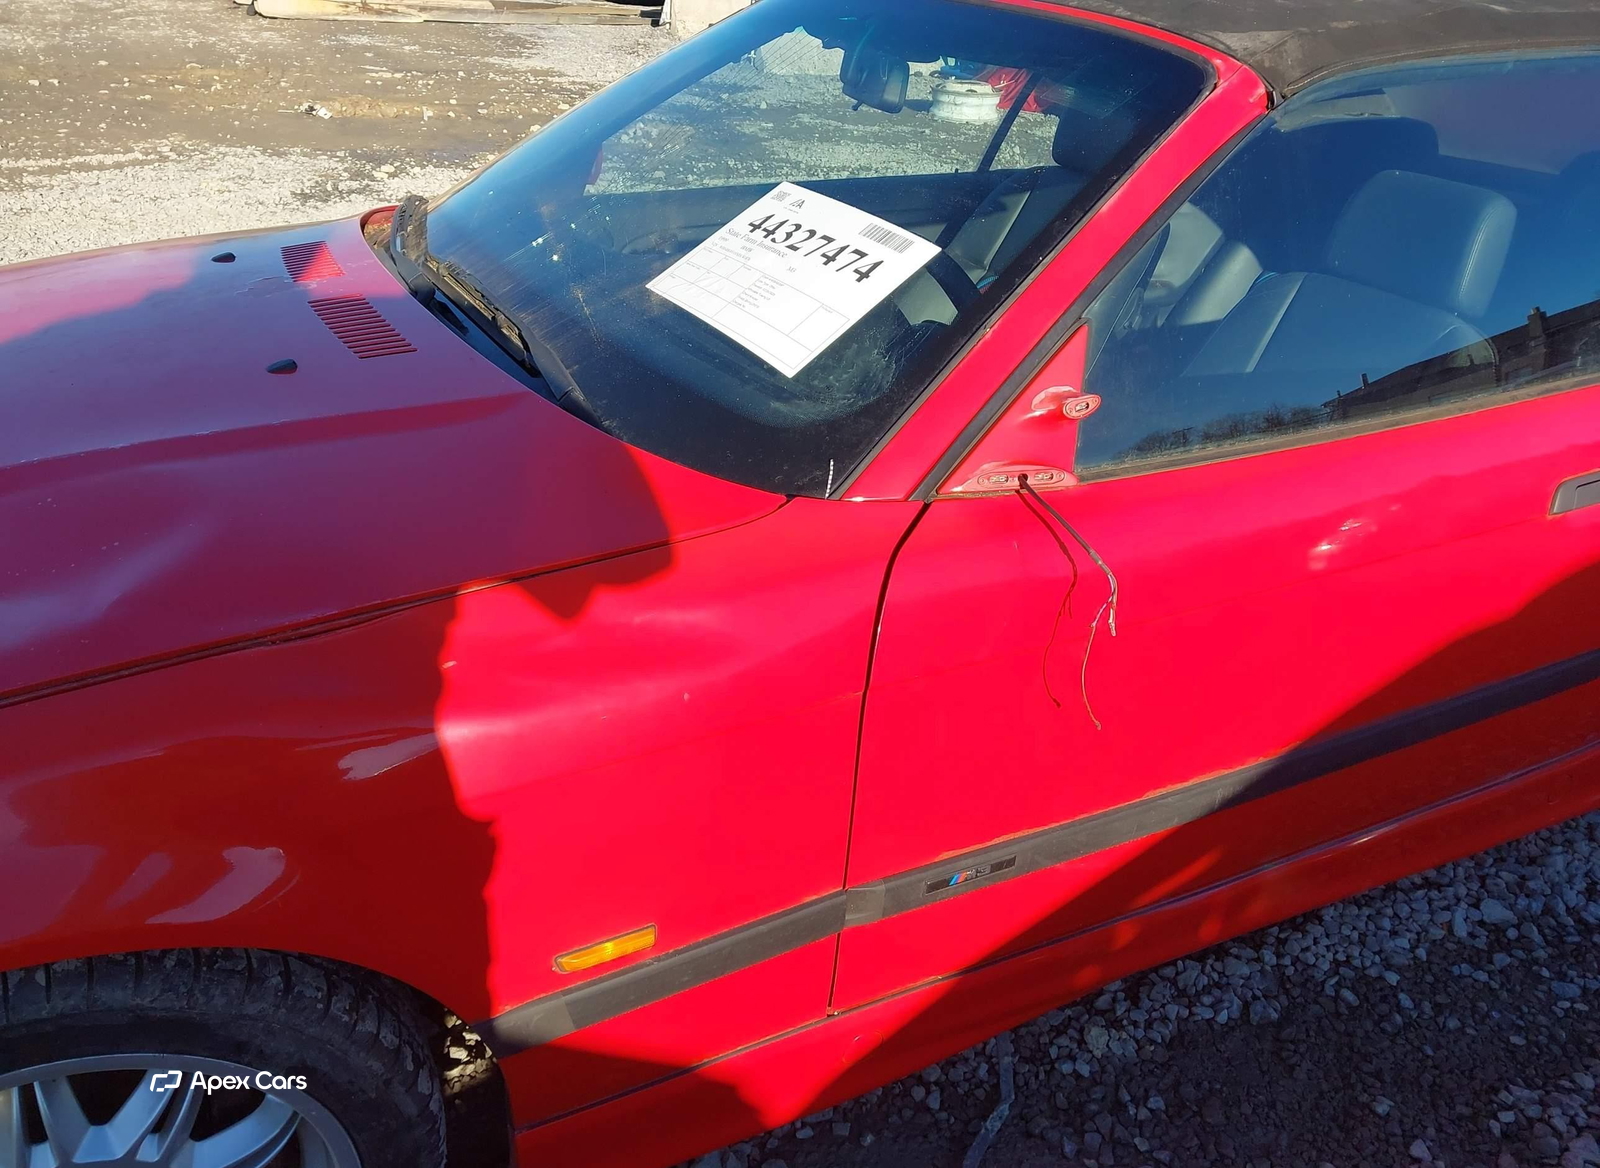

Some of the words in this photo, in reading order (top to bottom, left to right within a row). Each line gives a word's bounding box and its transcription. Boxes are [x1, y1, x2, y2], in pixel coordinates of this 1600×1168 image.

[725, 227, 741, 238] State
[740, 233, 758, 245] Farm
[756, 240, 788, 258] Insurance
[747, 213, 884, 283] 44327474
